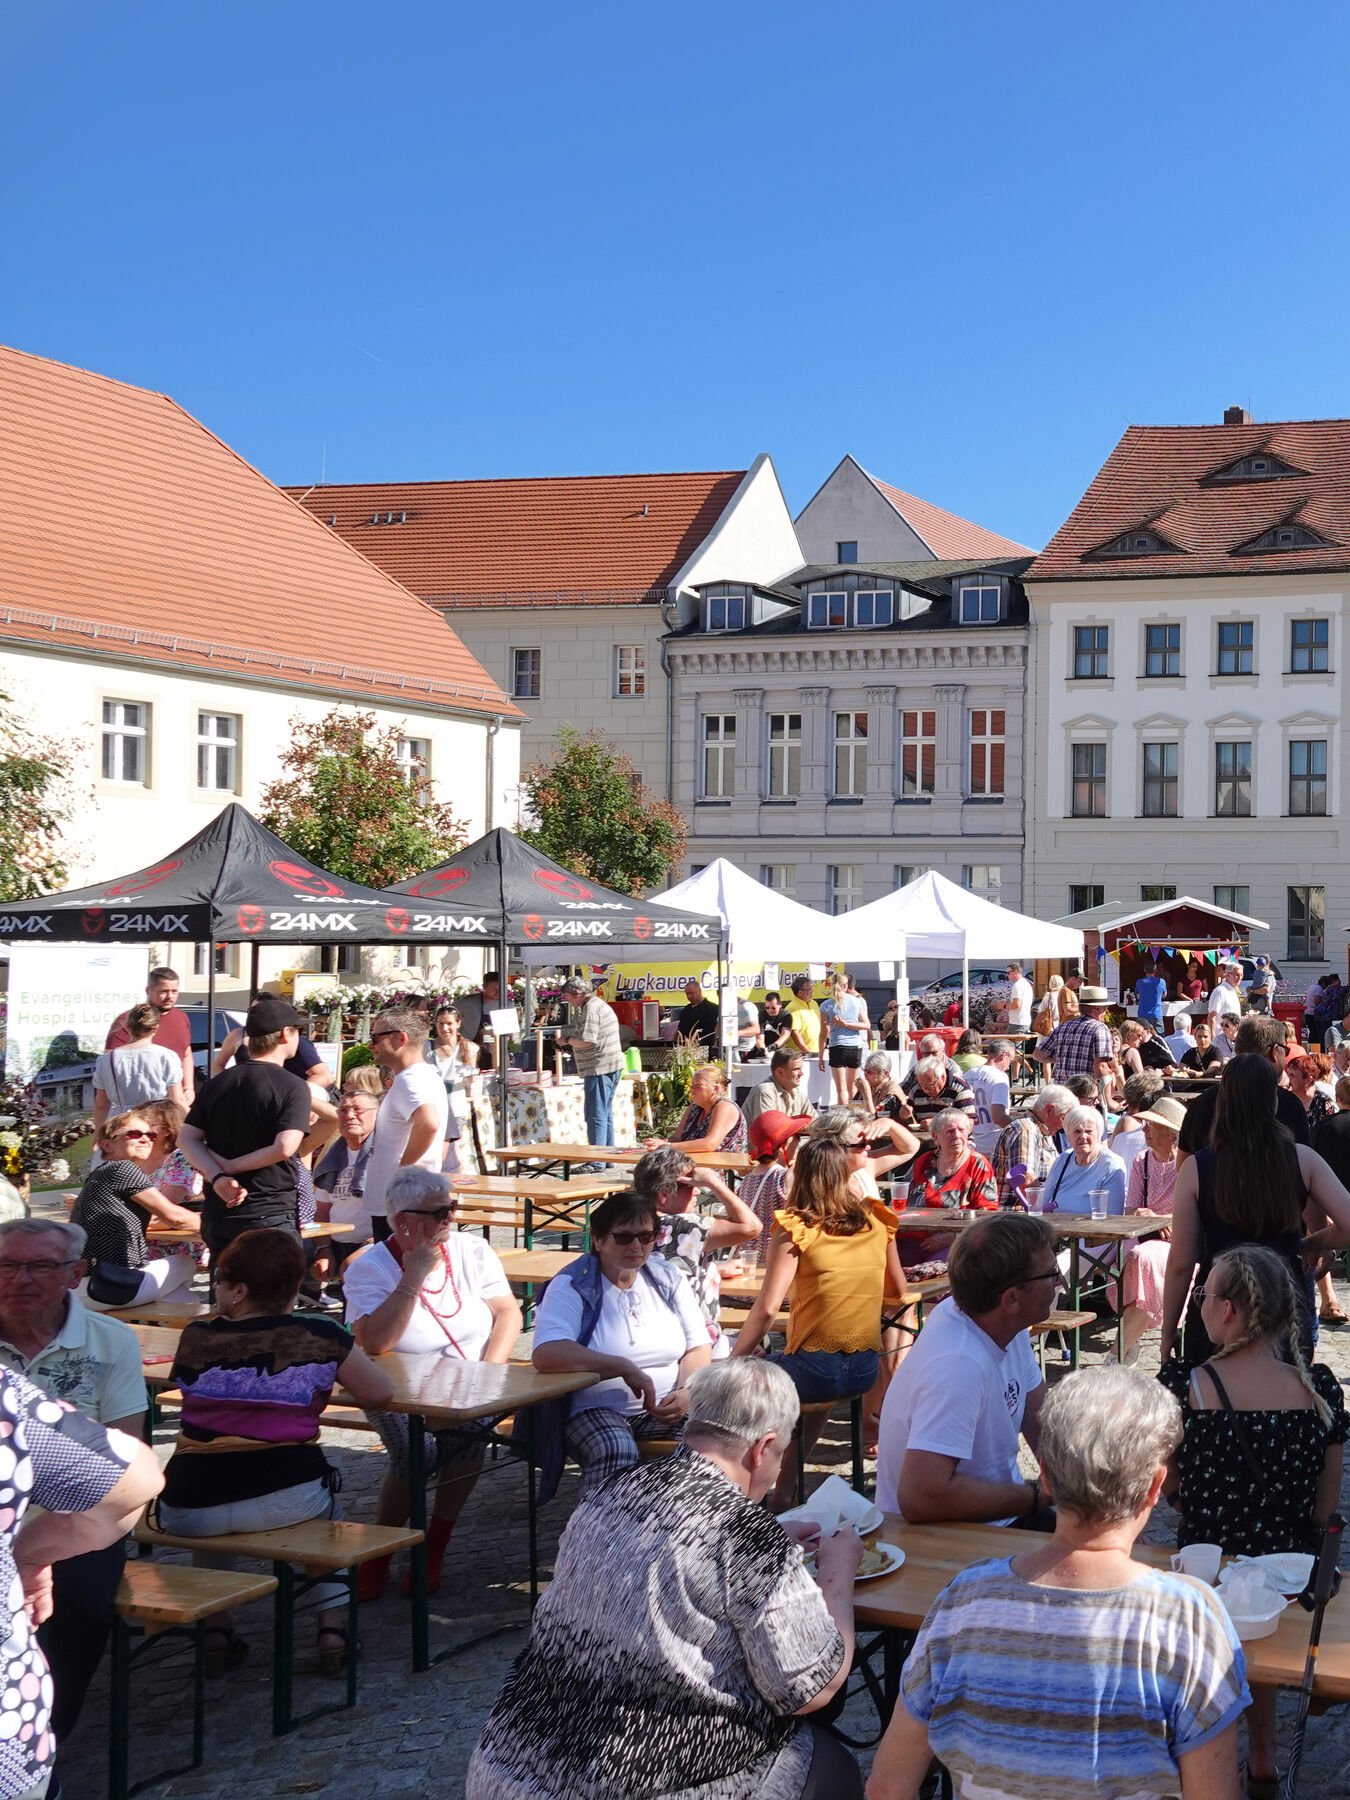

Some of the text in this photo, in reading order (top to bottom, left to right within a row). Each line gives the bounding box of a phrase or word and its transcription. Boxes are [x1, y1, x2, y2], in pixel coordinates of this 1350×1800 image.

[109, 914, 190, 932] 24MX
[270, 912, 358, 931] 24MX
[412, 914, 488, 934] 24MX
[547, 920, 613, 936] 24MX
[654, 922, 710, 939] 24MX
[20, 991, 140, 1007] Evangelisches
[18, 1011, 76, 1027] Hospiz
